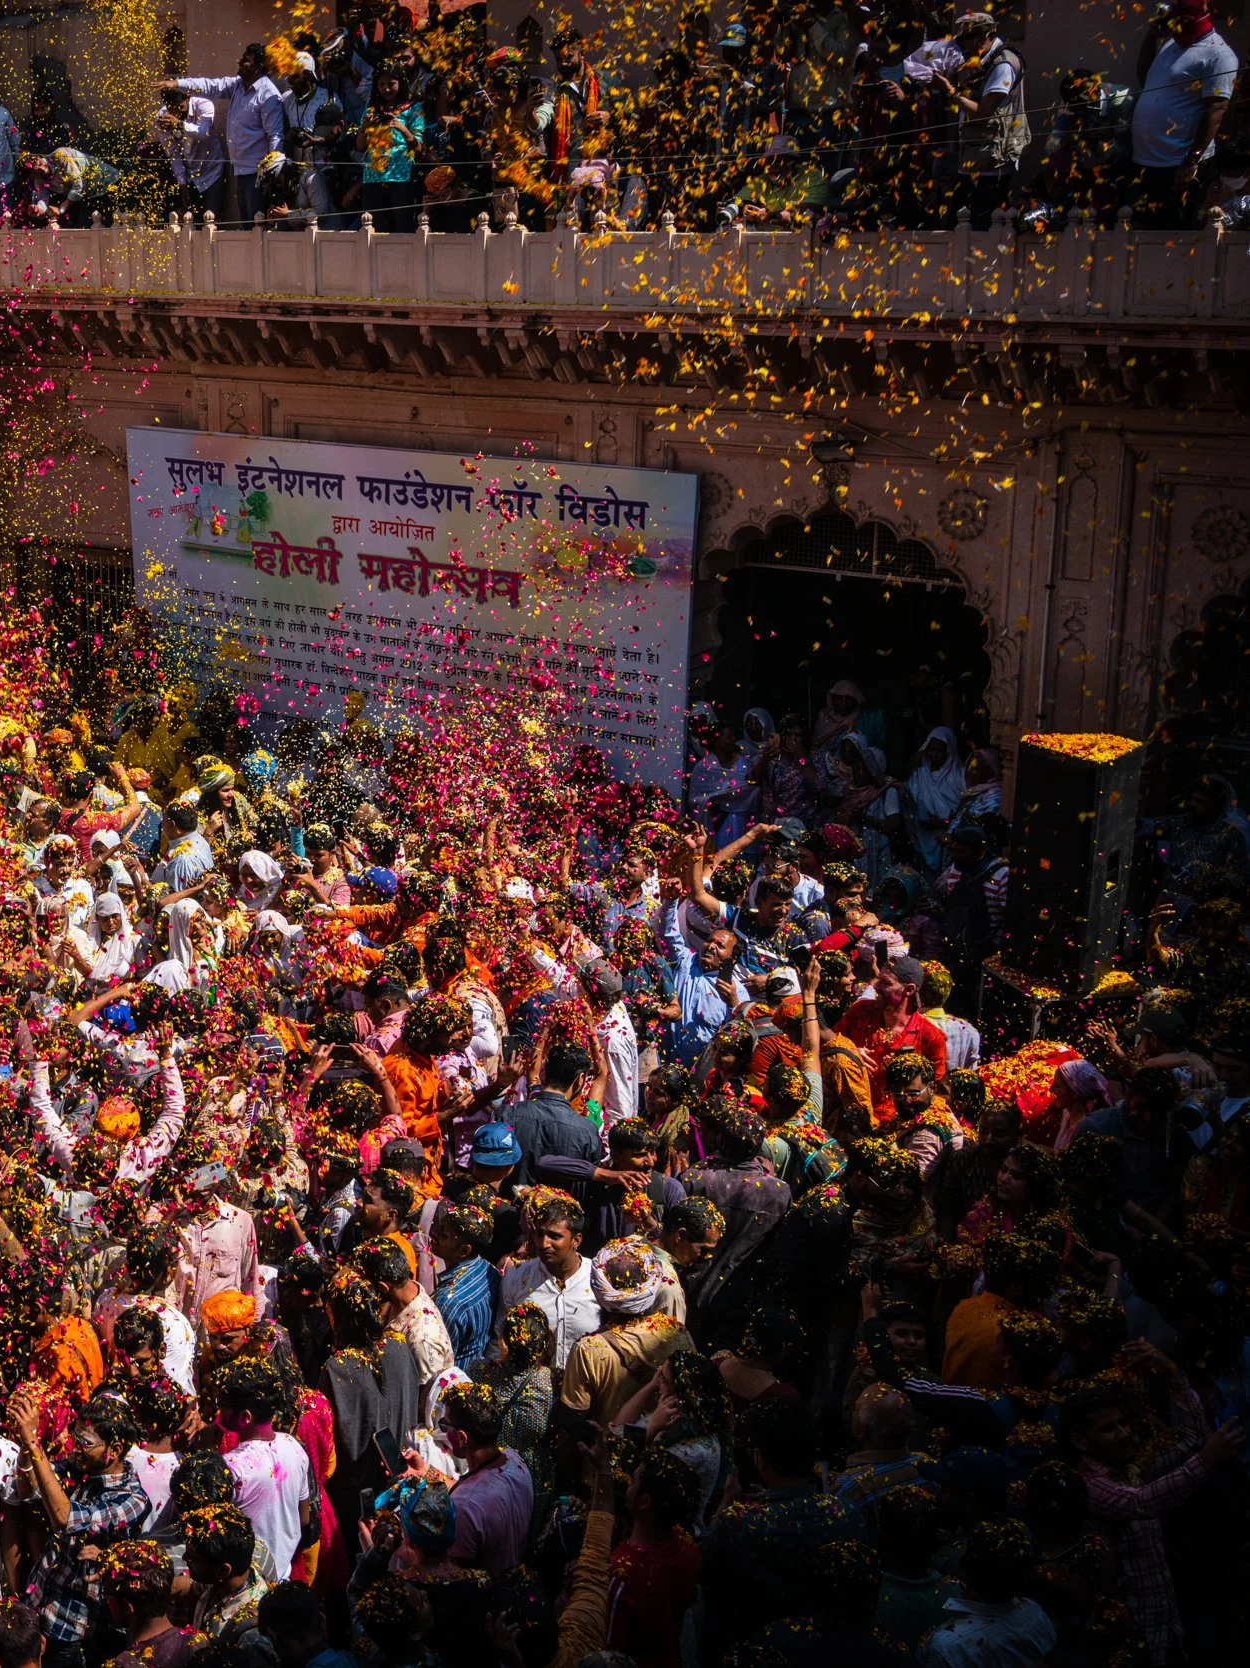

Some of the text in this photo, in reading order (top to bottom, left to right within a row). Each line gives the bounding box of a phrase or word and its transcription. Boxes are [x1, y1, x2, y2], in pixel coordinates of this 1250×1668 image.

[164, 457, 225, 492] सुलभ
[356, 469, 474, 513] फाउंडेशन
[555, 484, 650, 531] विडोस
[331, 515, 360, 535] द्वारा
[251, 530, 525, 609] होली महोत्सव
[261, 597, 269, 609] के
[274, 601, 290, 612] साथ
[294, 604, 307, 615] हर
[309, 606, 327, 617] साल
[345, 611, 363, 624] तरह
[274, 617, 285, 630] की
[288, 619, 307, 633] होली
[310, 623, 320, 635] भी
[352, 629, 361, 641] के
